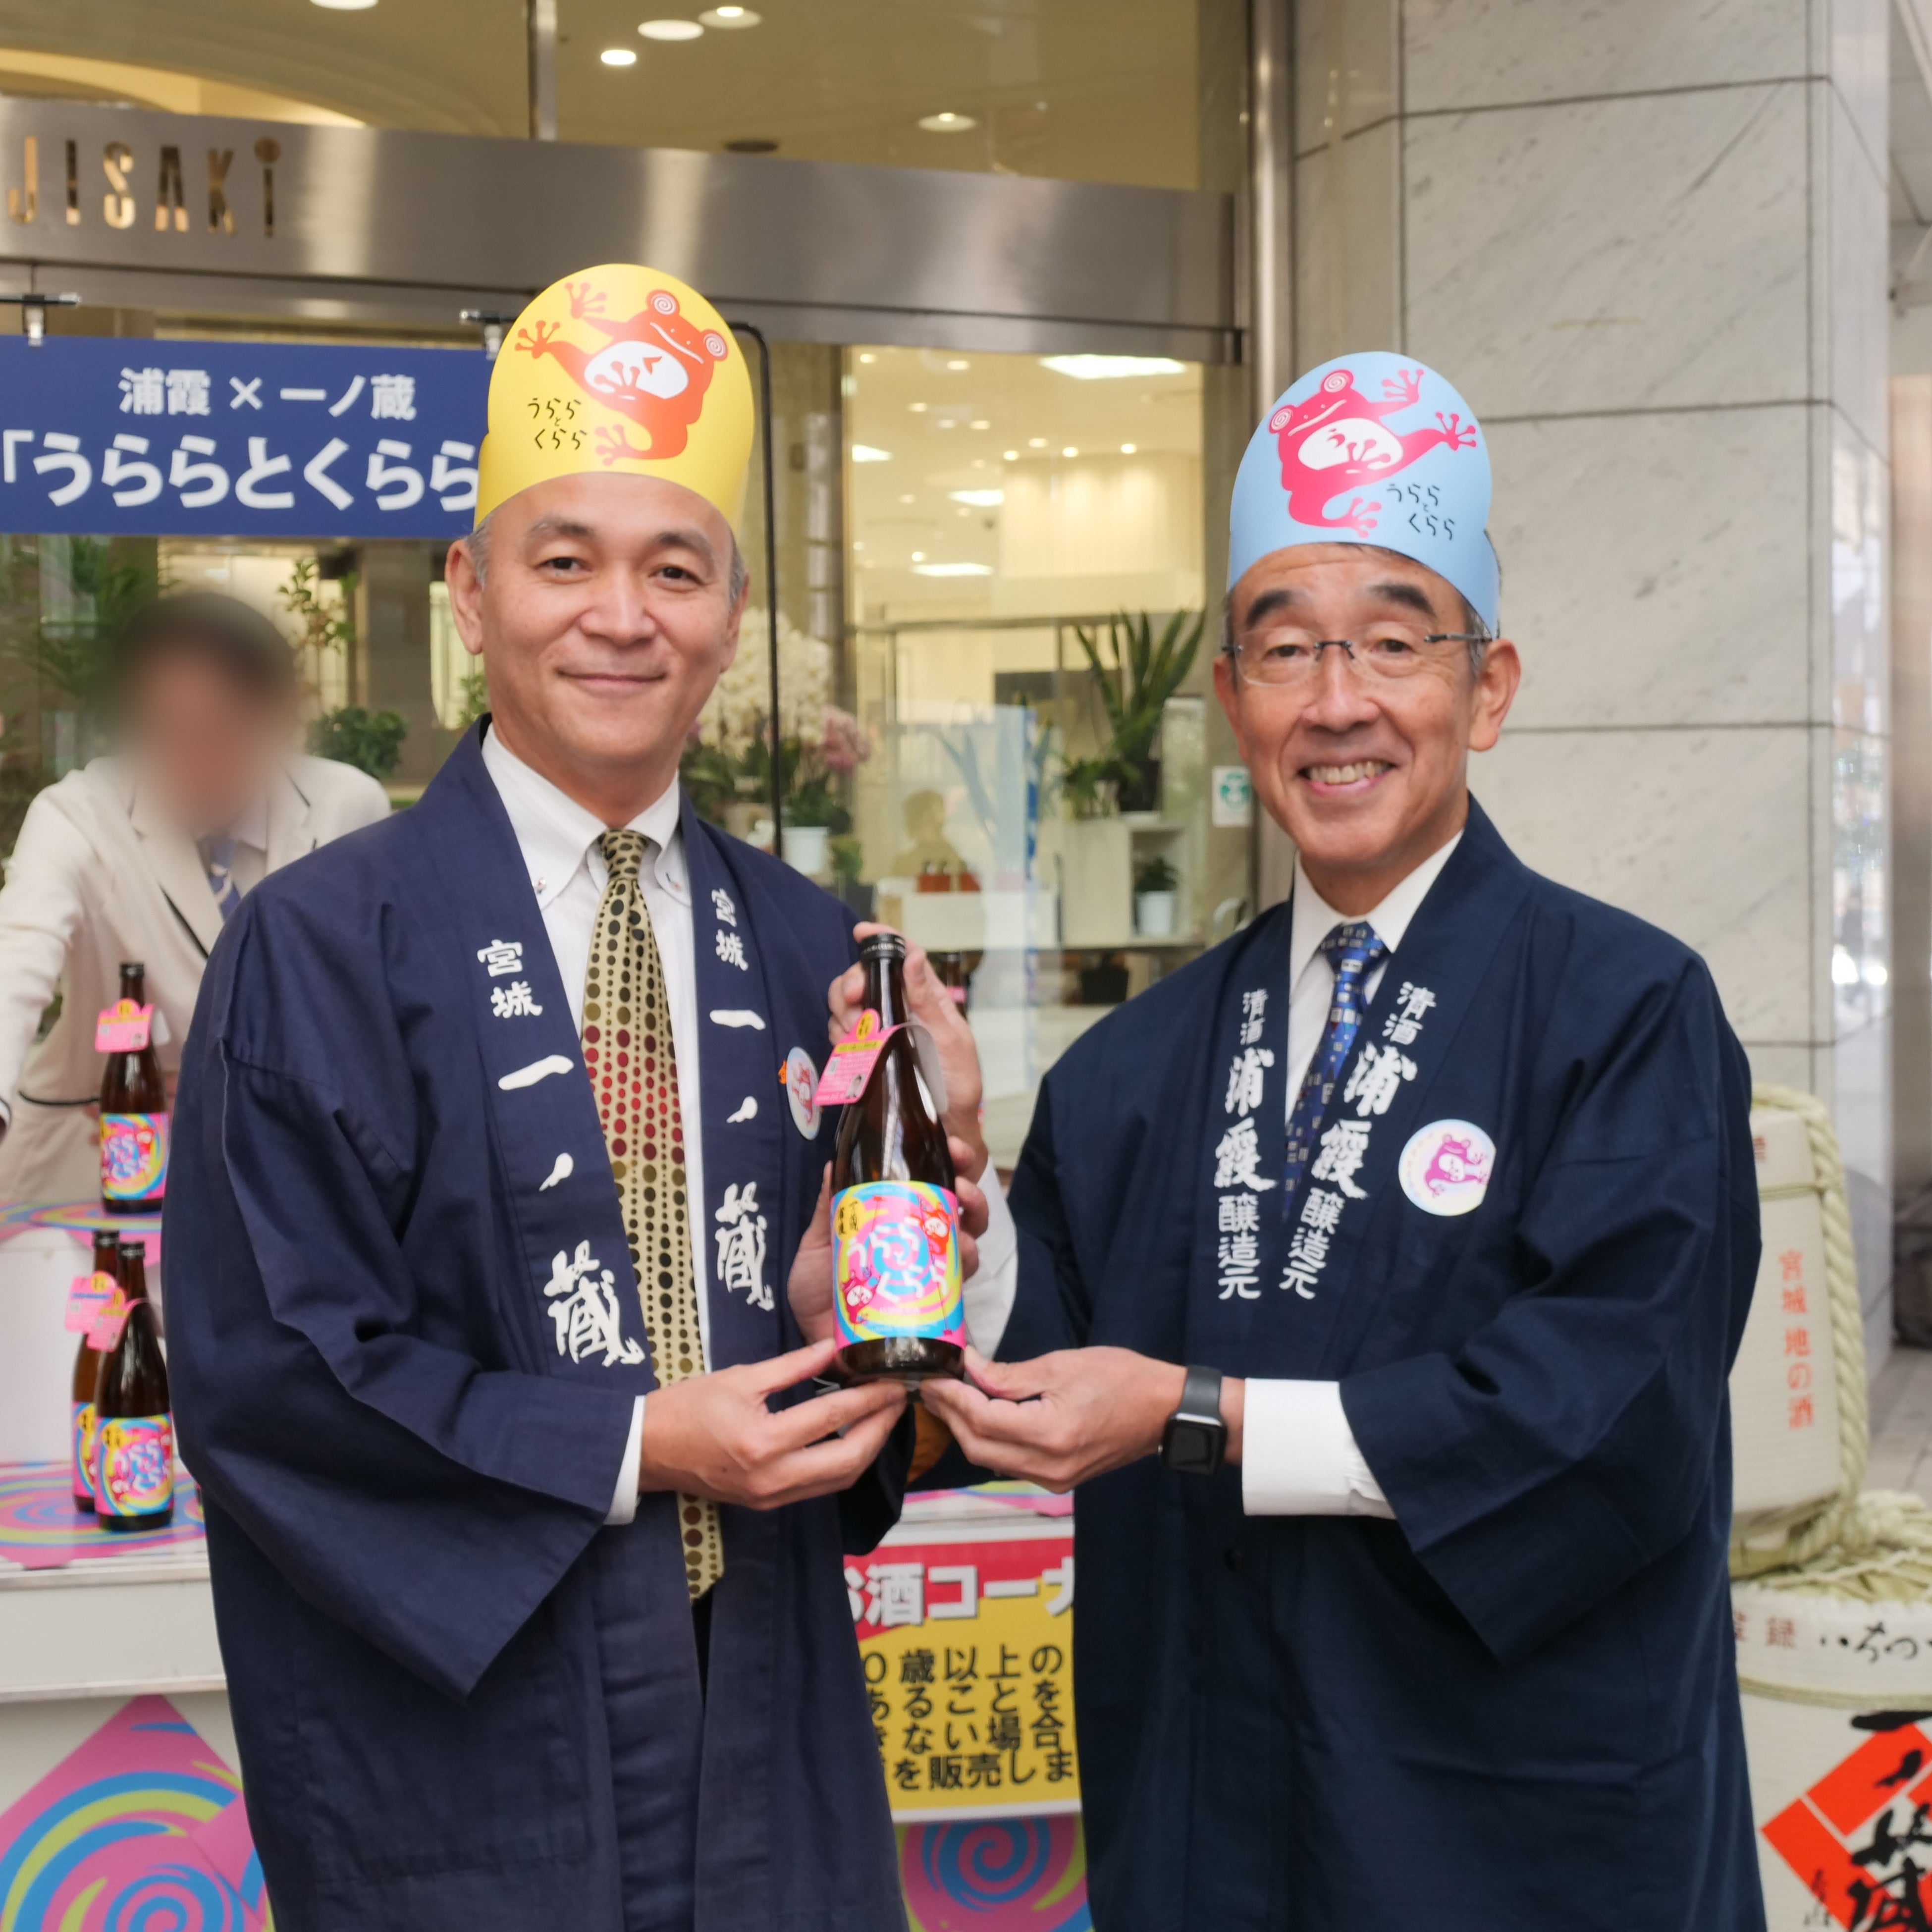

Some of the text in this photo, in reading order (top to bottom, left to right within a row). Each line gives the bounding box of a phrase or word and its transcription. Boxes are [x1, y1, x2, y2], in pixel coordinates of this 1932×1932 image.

[118, 366, 212, 417] 浦霞
[280, 374, 417, 420] 一ノ蔵
[527, 397, 581, 420] うらら
[535, 428, 587, 450] くらら
[1387, 483, 1440, 506] うらら
[1409, 512, 1455, 540] くらら
[477, 939, 543, 1019] 宮城
[1240, 988, 1269, 1045] 清酒
[1383, 981, 1437, 1046] 清酒
